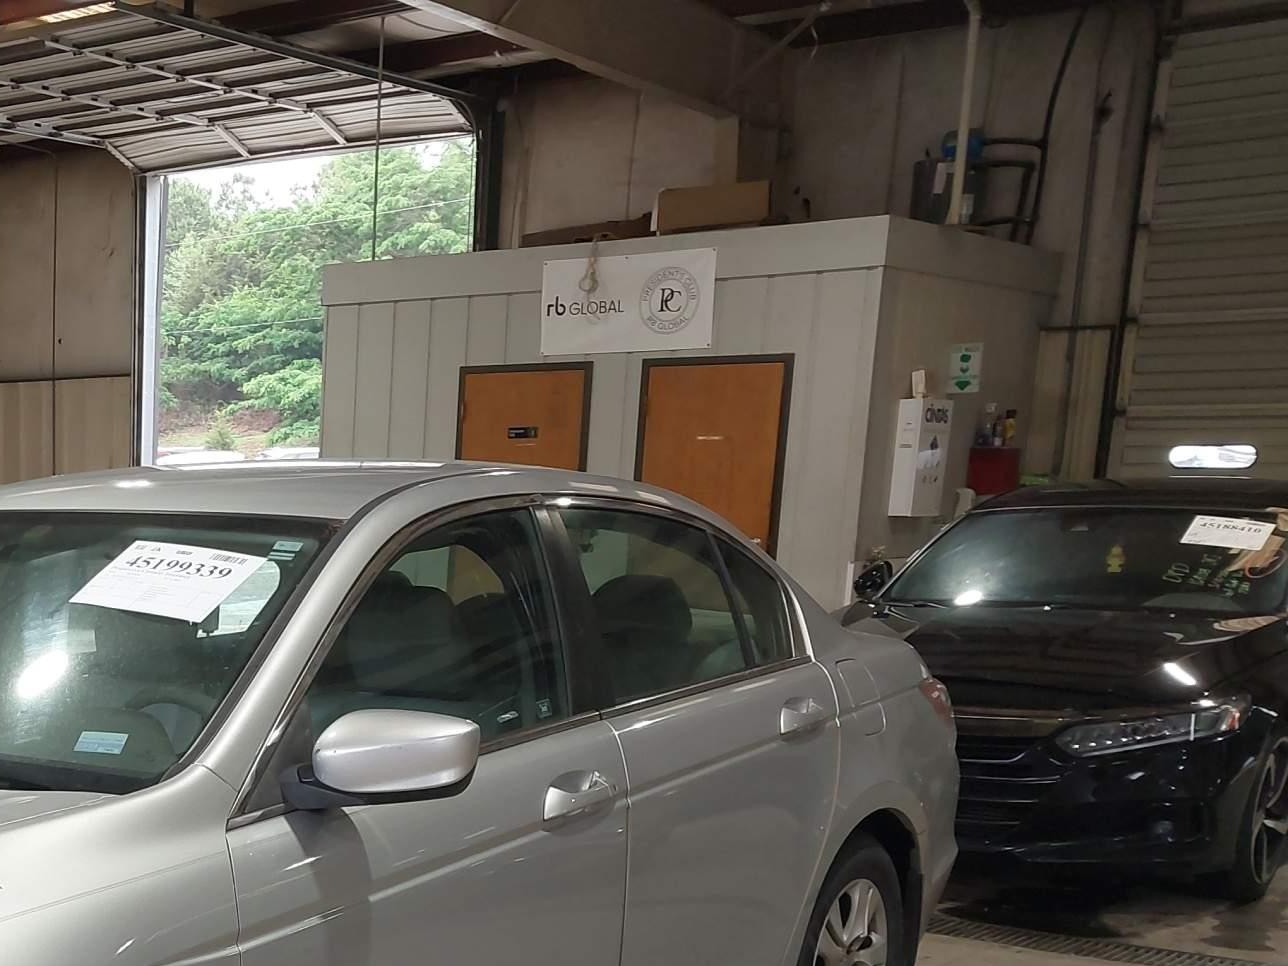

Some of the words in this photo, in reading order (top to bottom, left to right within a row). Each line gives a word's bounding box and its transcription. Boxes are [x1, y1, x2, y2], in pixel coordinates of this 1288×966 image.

[546, 296, 567, 317] rb
[569, 300, 625, 316] GLOBAL
[657, 315, 689, 331] GLOBAL
[126, 556, 233, 579] 45199339
